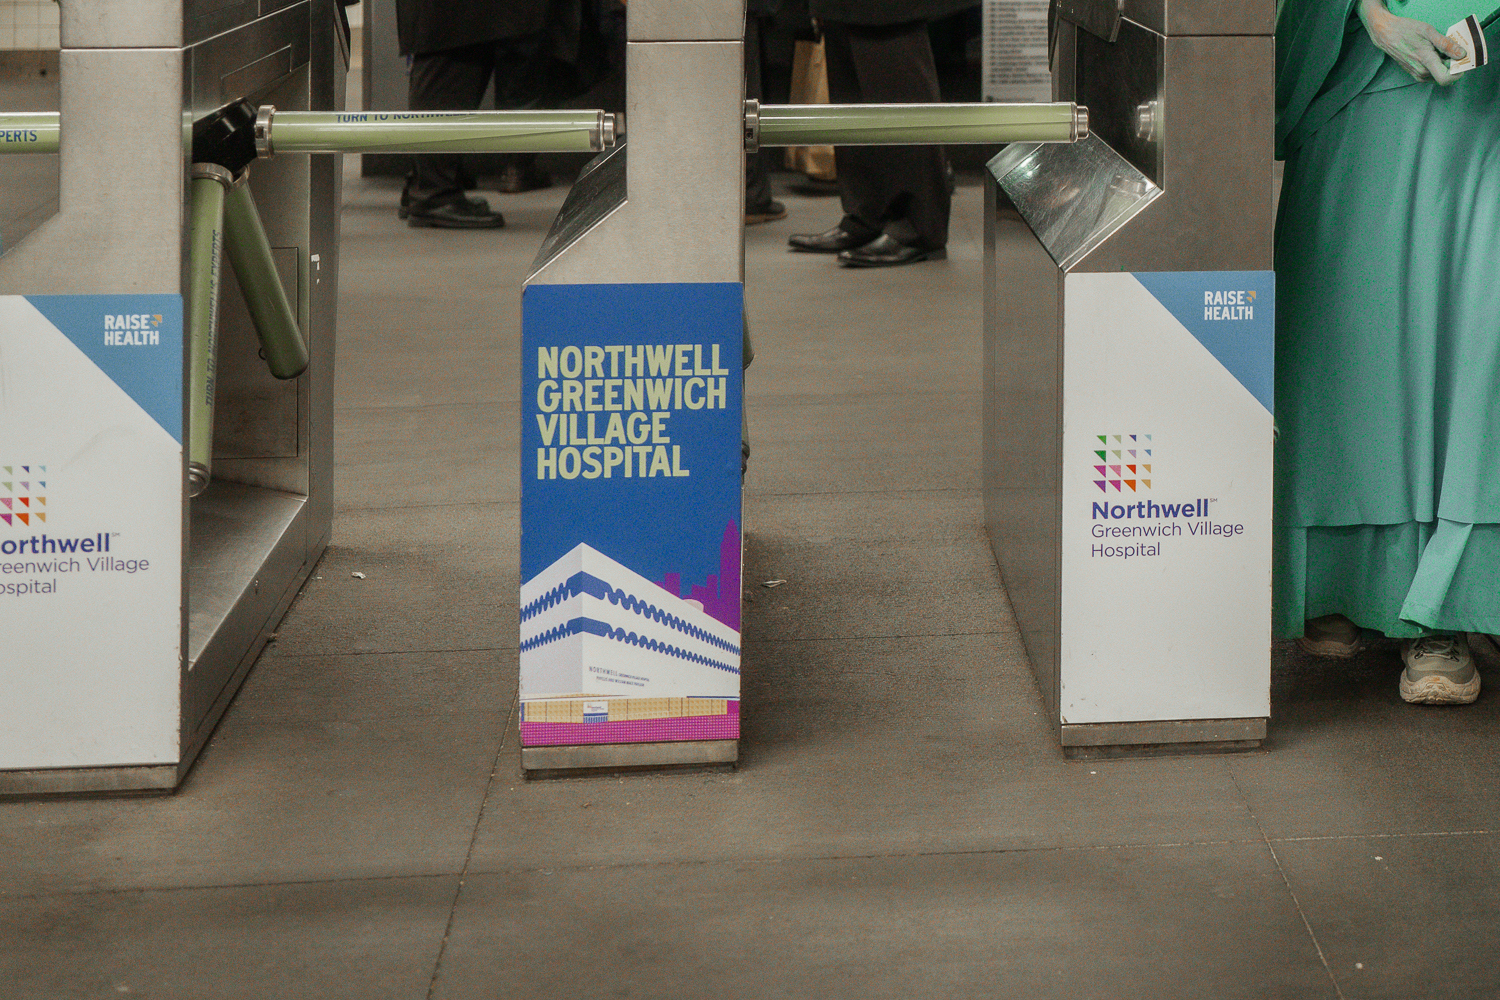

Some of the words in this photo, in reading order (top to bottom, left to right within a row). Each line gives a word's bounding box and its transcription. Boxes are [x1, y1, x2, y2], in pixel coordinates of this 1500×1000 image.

[1204, 290, 1245, 305] RAISE
[1204, 306, 1253, 320] HEALTH
[104, 314, 150, 330] RAISE
[104, 331, 160, 346] HEALTH
[538, 344, 729, 379] NORTHWELL
[537, 377, 726, 413] GREENWICH
[536, 411, 671, 446] VILLAGE
[537, 445, 690, 480] HOSPITAL
[1092, 498, 1209, 520] Northwell
[1091, 522, 1182, 538] Greenwich
[1187, 521, 1244, 537] Village
[1091, 542, 1161, 559] Hospital
[0, 557, 80, 574] eenwich
[86, 556, 149, 574] Village
